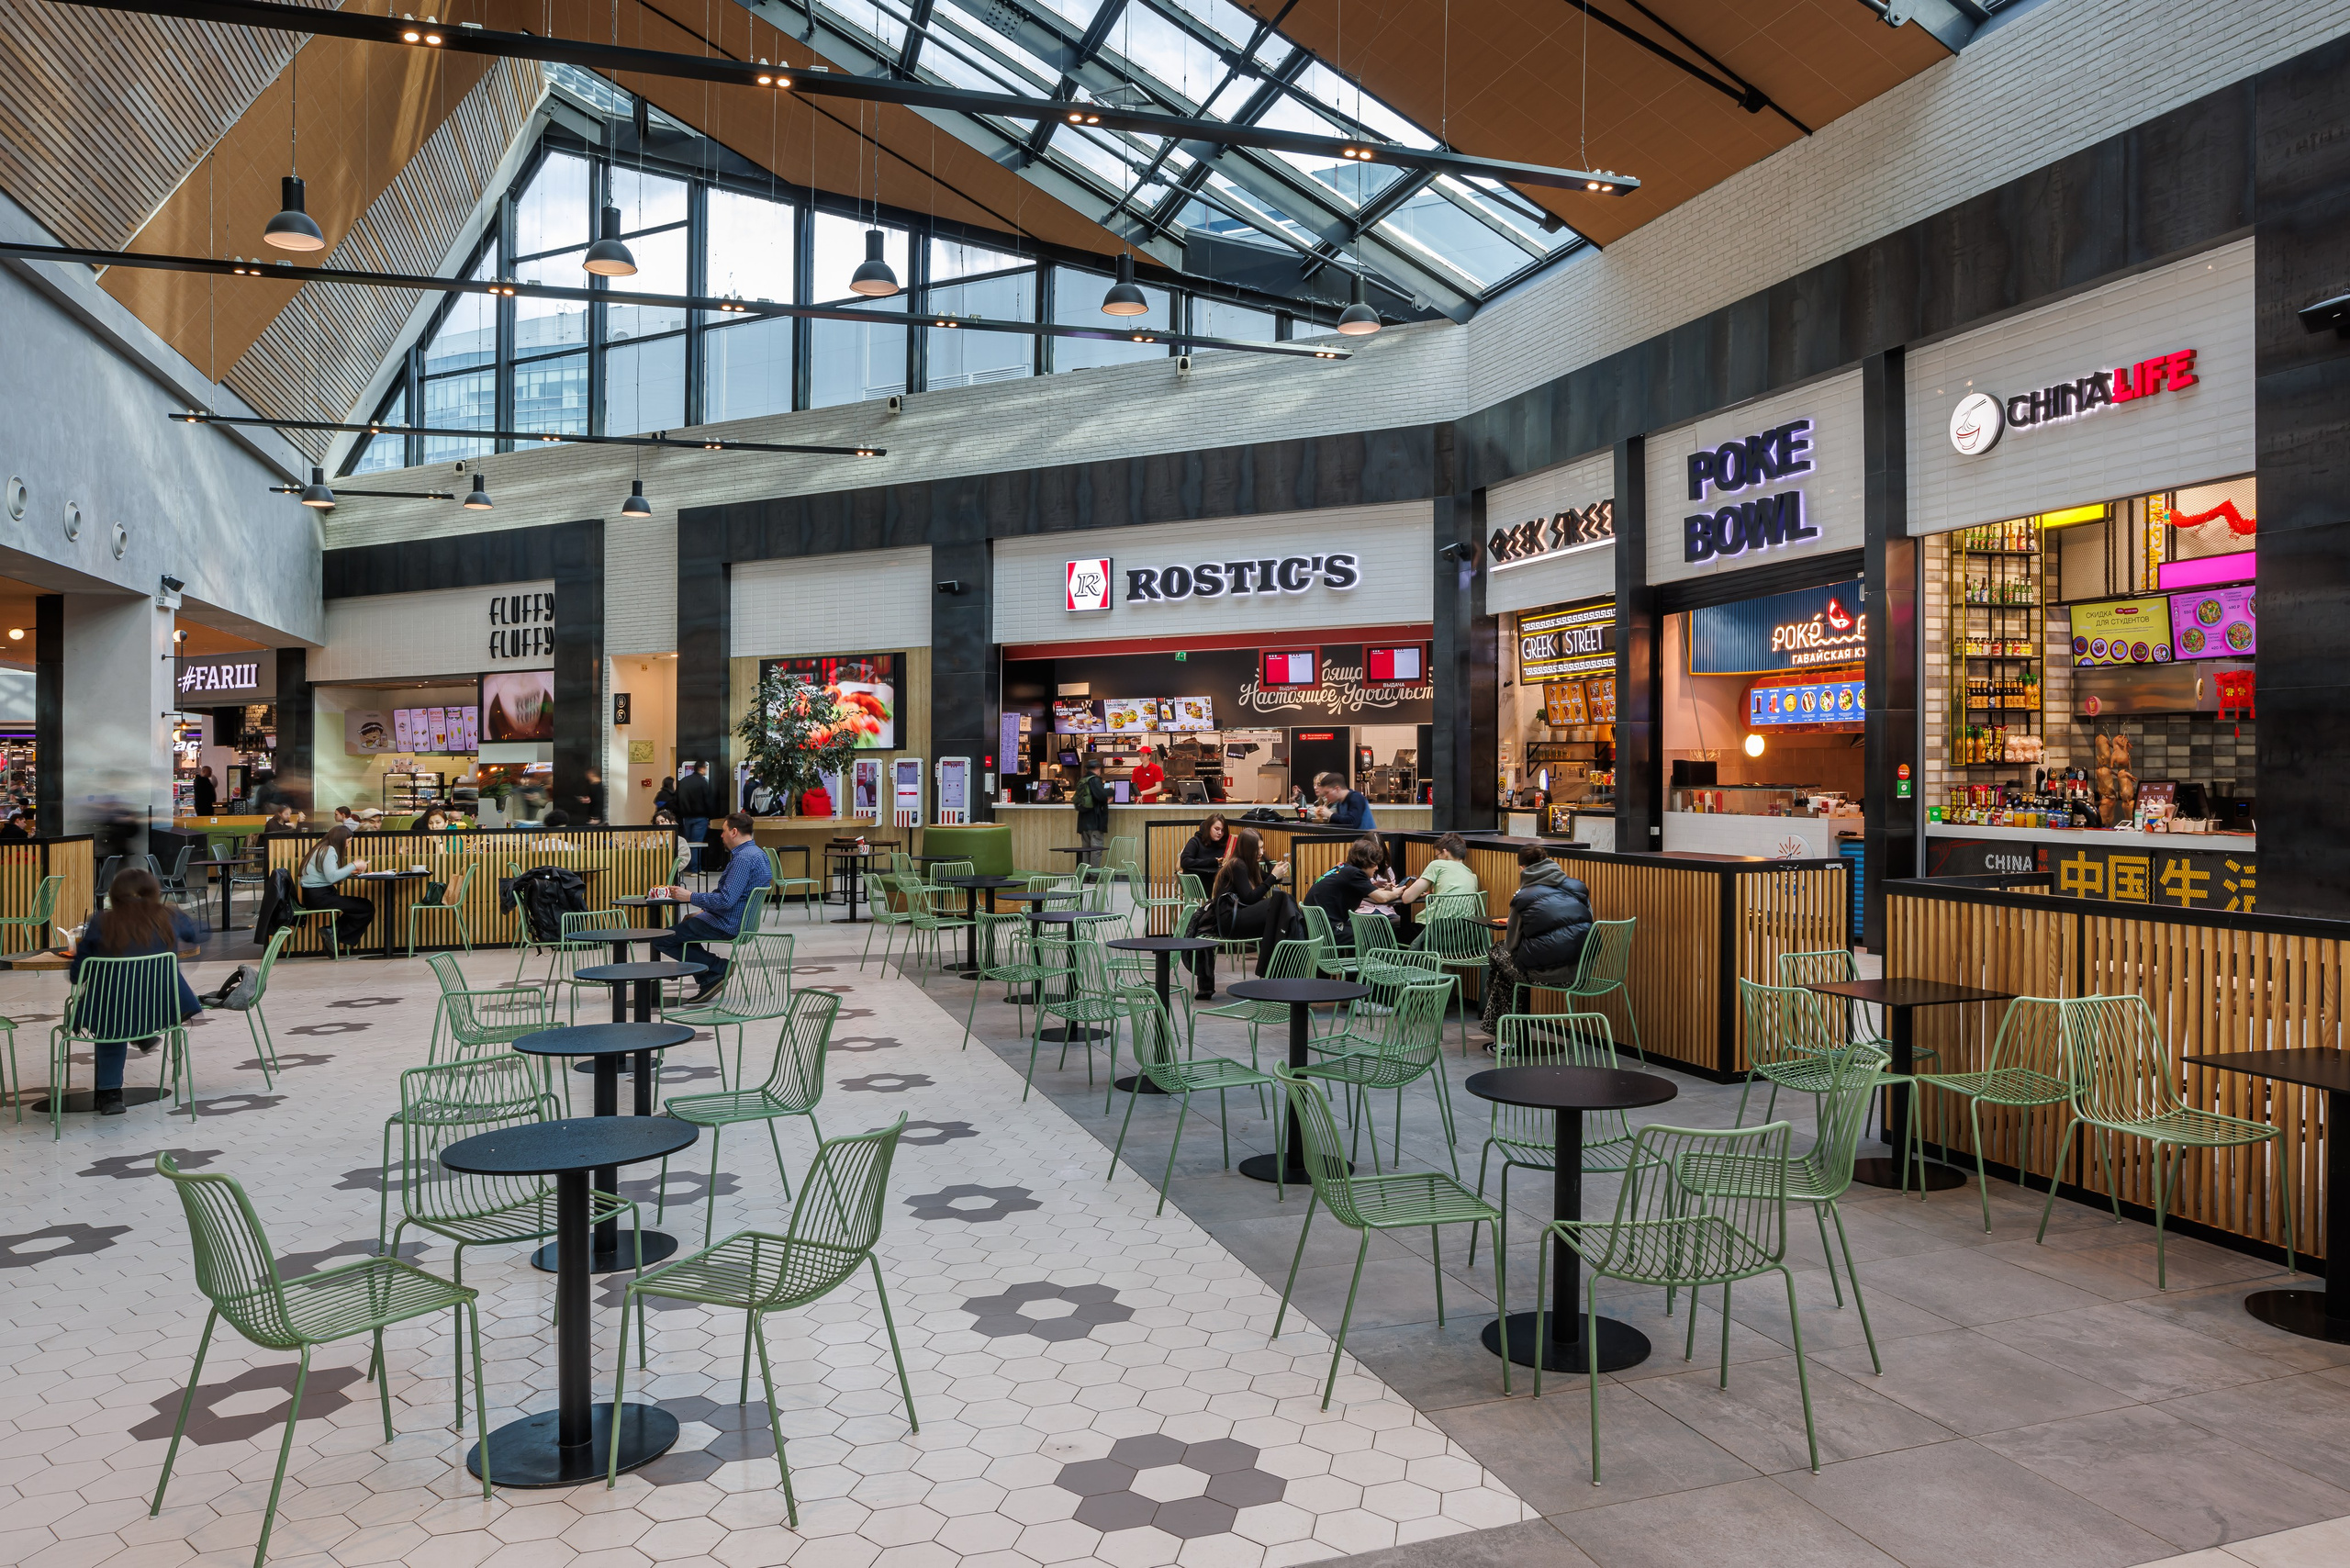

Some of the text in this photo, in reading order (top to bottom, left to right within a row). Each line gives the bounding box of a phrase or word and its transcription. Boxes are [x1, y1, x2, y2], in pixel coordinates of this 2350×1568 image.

[1687, 420, 1813, 500] POKE
[1488, 518, 1545, 562] GREEK
[1684, 491, 1819, 563] BOWL
[1126, 554, 1358, 601] ROSTIC'S
[489, 592, 554, 625] FLUFFY
[2086, 610, 2112, 619] СКИДКА
[2096, 616, 2150, 627] ДЛЯ СТУДЕНТОВ
[489, 626, 554, 658] FLUFFY
[1522, 627, 1603, 660] GREEK STREET
[1792, 649, 1851, 665] ГАВАЙСКАЯ
[1986, 854, 2032, 872] CHINA
